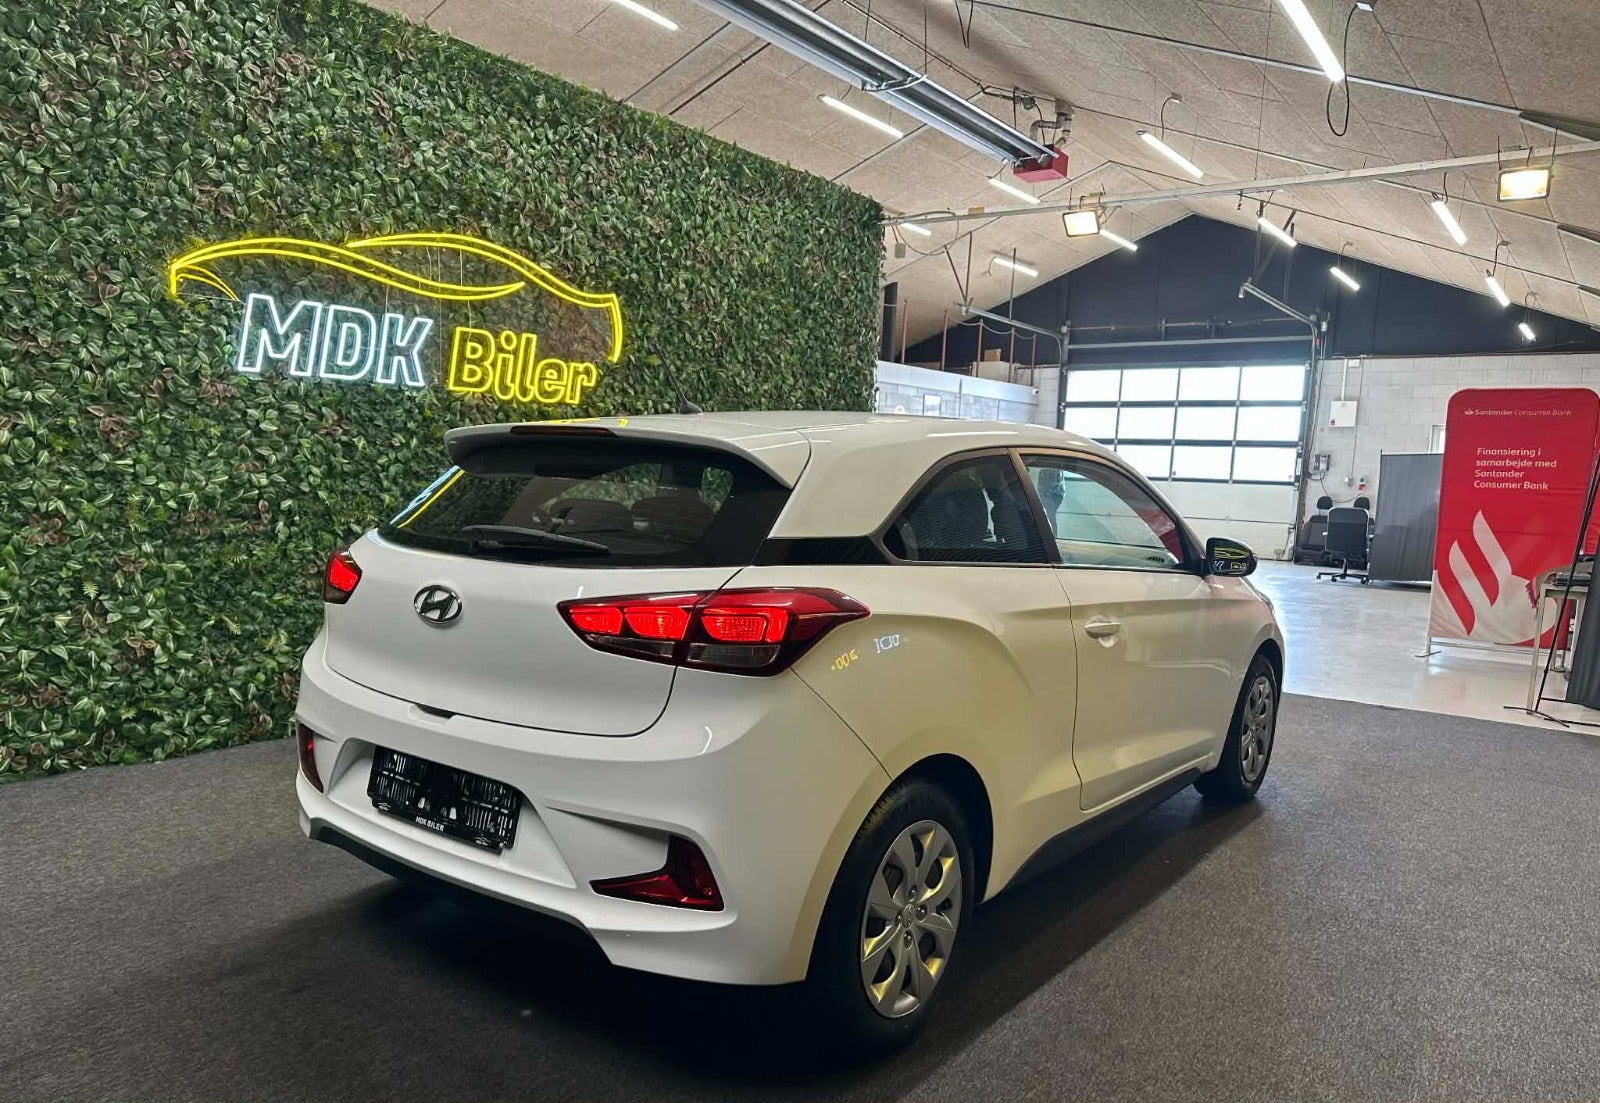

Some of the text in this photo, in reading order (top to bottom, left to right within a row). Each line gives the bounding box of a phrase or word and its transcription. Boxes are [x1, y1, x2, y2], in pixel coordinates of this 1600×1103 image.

[236, 293, 597, 405] MDK Biler
[1474, 408, 1513, 416] Santander
[1514, 408, 1551, 416] Consumer
[1476, 447, 1542, 457] Finansiering i
[1476, 459, 1557, 468] samarbejde med
[1474, 469, 1525, 478] Santander
[1473, 480, 1549, 490] Consumer Bank
[426, 820, 444, 832] BILER
